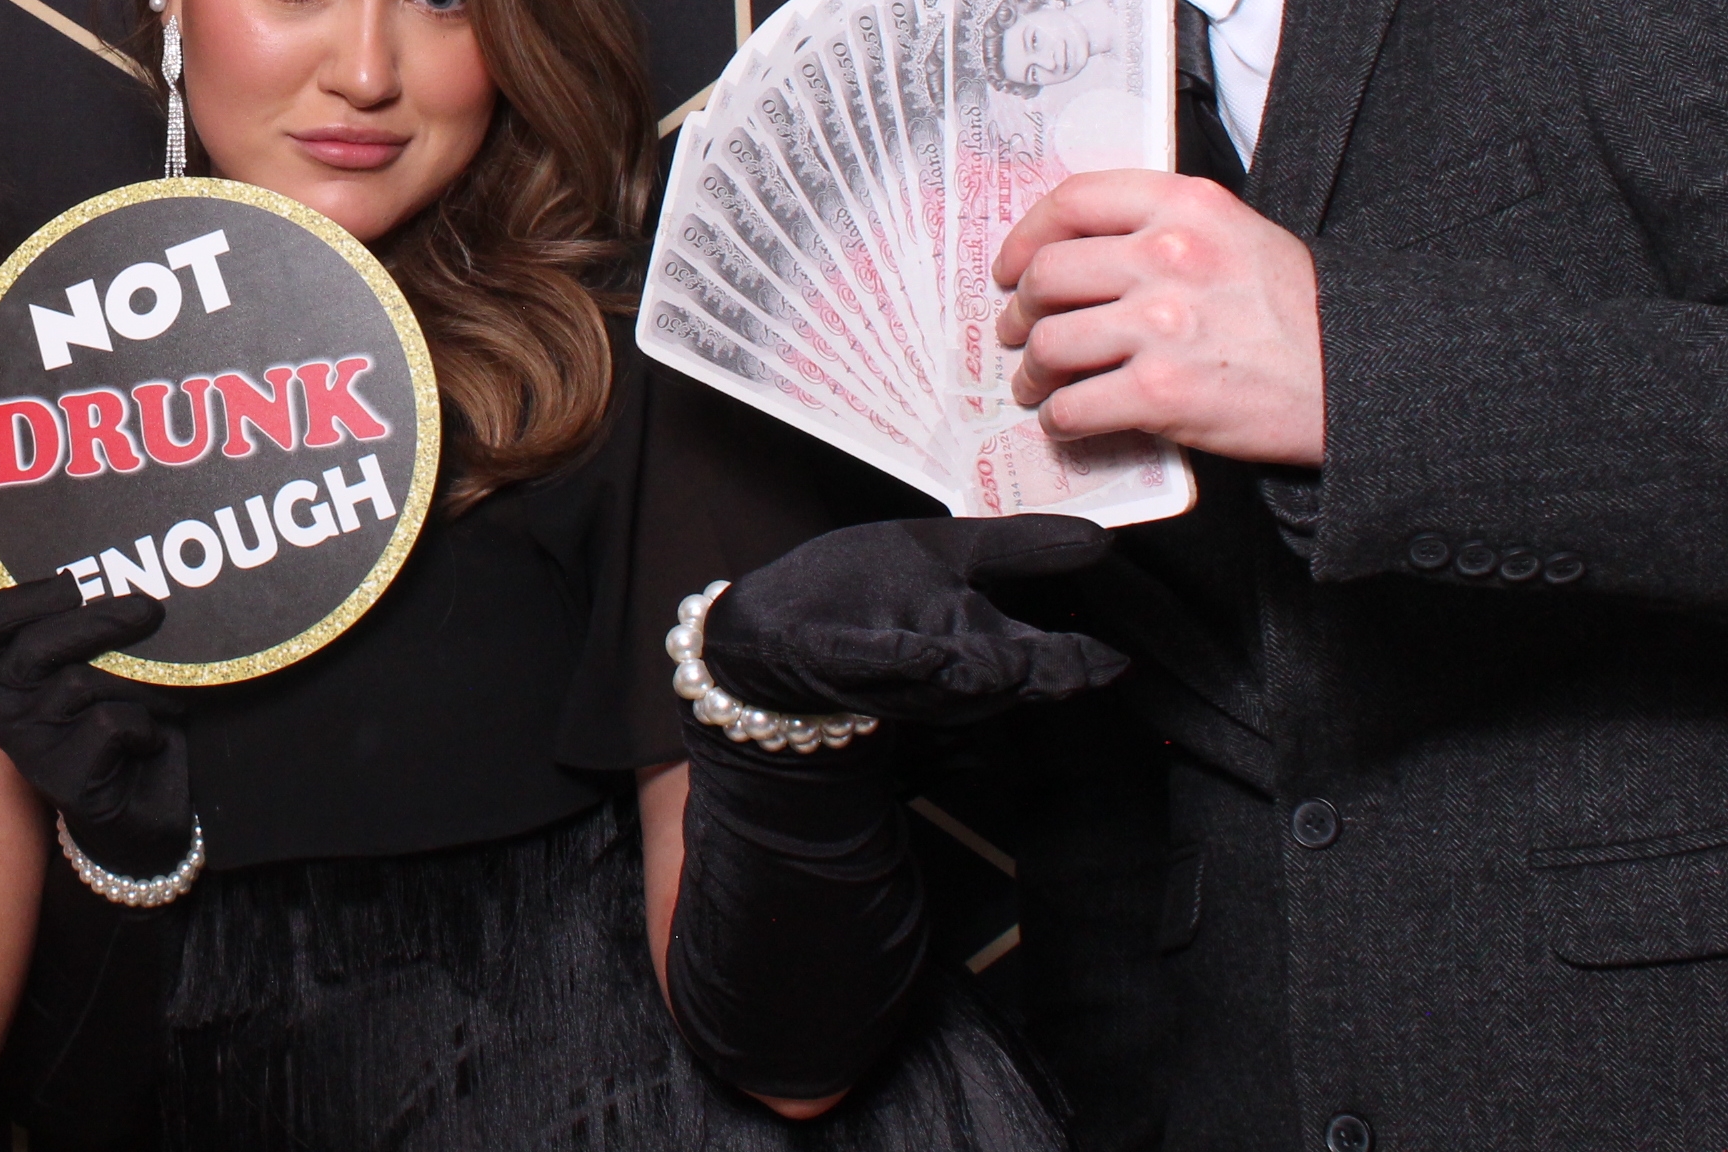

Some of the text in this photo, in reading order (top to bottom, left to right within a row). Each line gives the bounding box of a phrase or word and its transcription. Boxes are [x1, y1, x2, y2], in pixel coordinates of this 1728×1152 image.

[858, 15, 882, 62] £50
[891, 2, 913, 50] £50
[802, 63, 832, 105] £50
[762, 99, 793, 139] £50
[729, 139, 762, 176] £50
[1010, 111, 1046, 193] Pounds
[703, 176, 737, 210] £50
[998, 135, 1013, 223] FIFTY
[684, 226, 721, 258] £50
[664, 261, 703, 291] £50
[29, 229, 231, 371] NOT
[656, 313, 694, 339] £50
[965, 324, 983, 383] £50
[995, 355, 1003, 380] N34
[977, 459, 1003, 515] £50
[999, 430, 1023, 507] N34 20222
